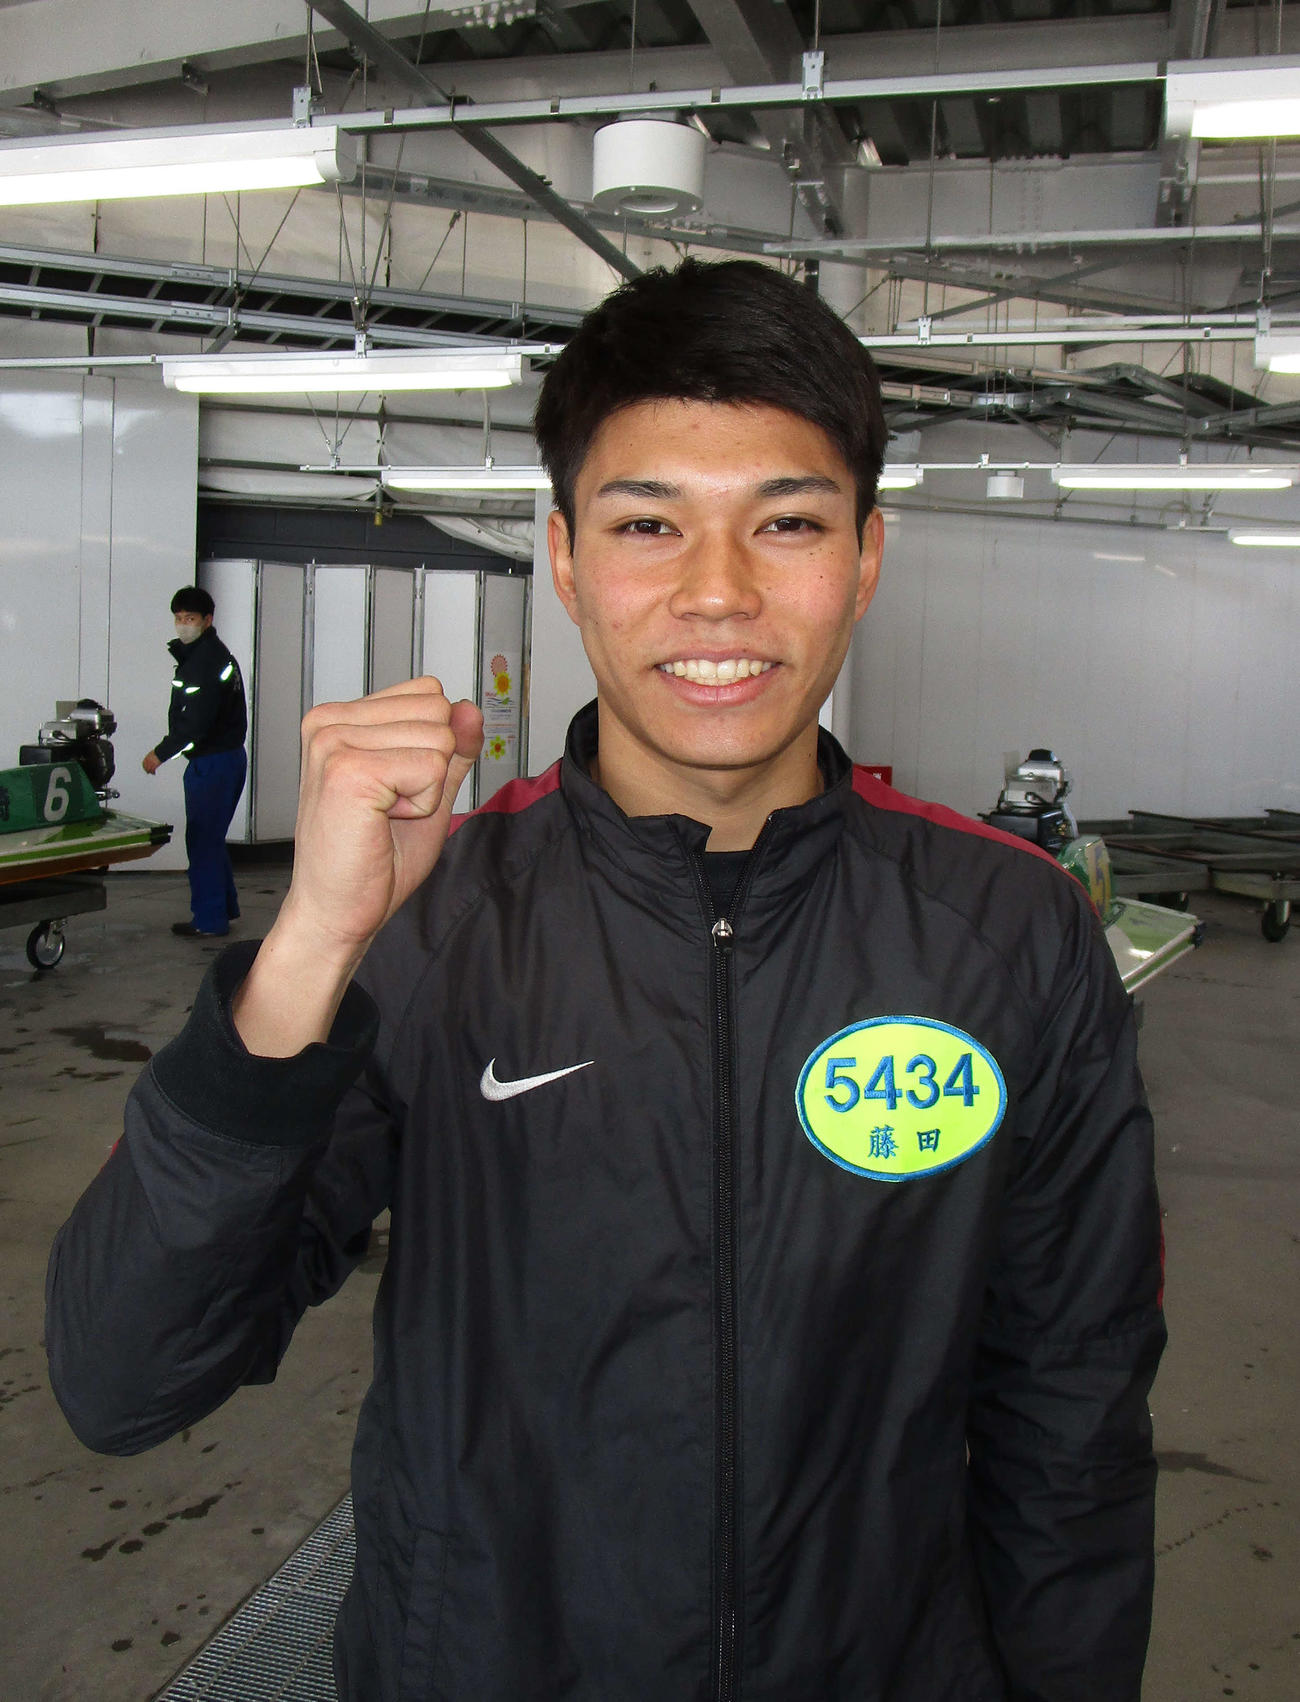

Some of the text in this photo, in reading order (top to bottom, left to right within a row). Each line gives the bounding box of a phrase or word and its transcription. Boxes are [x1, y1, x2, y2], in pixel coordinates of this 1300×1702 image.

[43, 766, 72, 822] 6
[824, 1053, 980, 1113] 5434
[867, 1124, 941, 1160] 藤田
